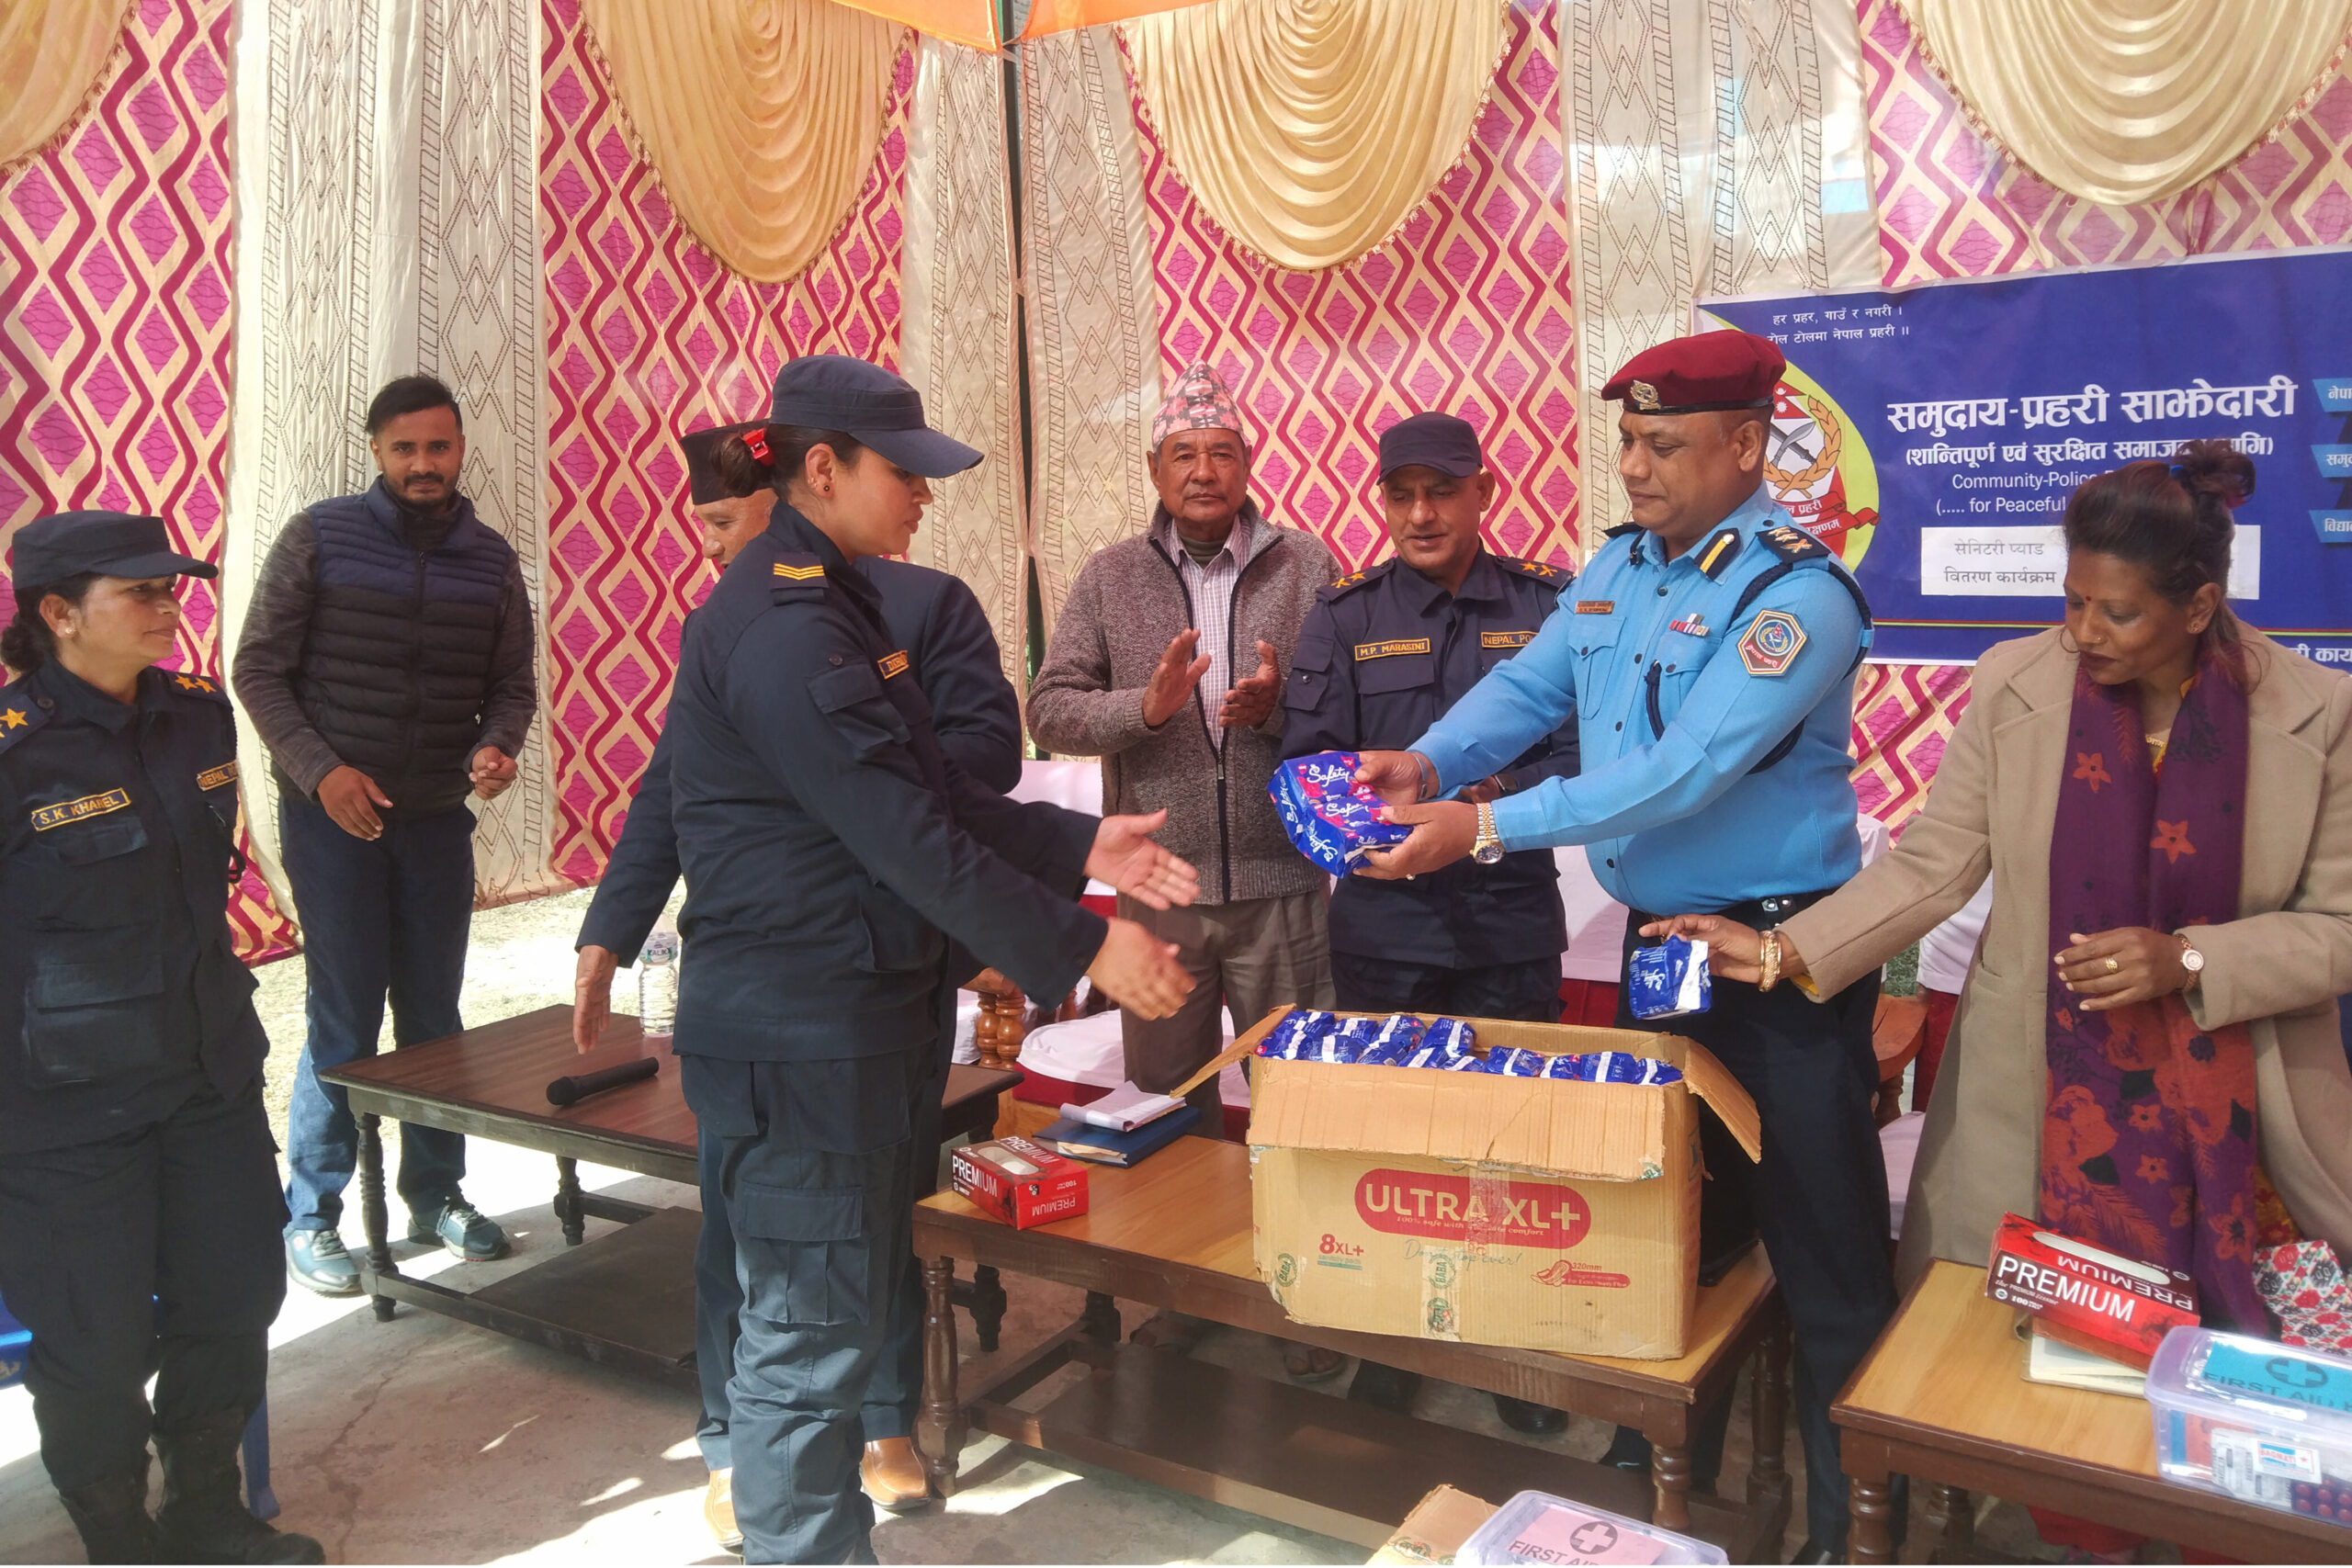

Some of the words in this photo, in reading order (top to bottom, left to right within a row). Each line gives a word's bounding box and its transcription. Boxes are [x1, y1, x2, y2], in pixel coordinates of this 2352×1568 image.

[1772, 314, 1788, 325] हर
[1792, 311, 1818, 324] प्रहर,
[1851, 309, 1860, 319] र
[1865, 304, 1893, 318] नगरी
[1793, 331, 1827, 344] टोलमा
[1833, 328, 1864, 341] नेपाल
[1869, 323, 1895, 338] प्रहरी
[2327, 386, 2352, 400] नेपा
[2002, 442, 2028, 462] एवं
[2032, 437, 2108, 467] सुरक्षित
[1969, 497, 1991, 513] for
[1996, 496, 2066, 513] Peaceful
[1954, 538, 2006, 556] सेनिटरी
[2008, 542, 2045, 556] प्याड
[1943, 566, 1992, 583] वितरण
[1996, 567, 2057, 583] कार्यक्रम
[1382, 642, 1425, 653] MARASINI
[1484, 634, 1514, 645] NEPAL
[1306, 764, 1351, 787] Safety
[39, 808, 69, 826] S.K.
[71, 795, 120, 817] KHAREL
[1000, 1135, 1060, 1164] PREMIUM
[952, 1155, 997, 1198] PREMIUM
[1032, 1197, 1076, 1217] PREMIUM
[1366, 1183, 1489, 1223] ULTRA
[1502, 1197, 1581, 1231] XL+
[1423, 1217, 1442, 1228] safe
[1443, 1220, 1464, 1229] with
[1508, 1227, 1544, 1236] comfort
[1435, 1261, 1448, 1283] BABA
[1996, 1255, 2136, 1323] PREMIUM
[2057, 1255, 2194, 1312] PREMIUM
[2203, 1371, 2282, 1396] FIRST
[1508, 1540, 1568, 1563] FIRST
